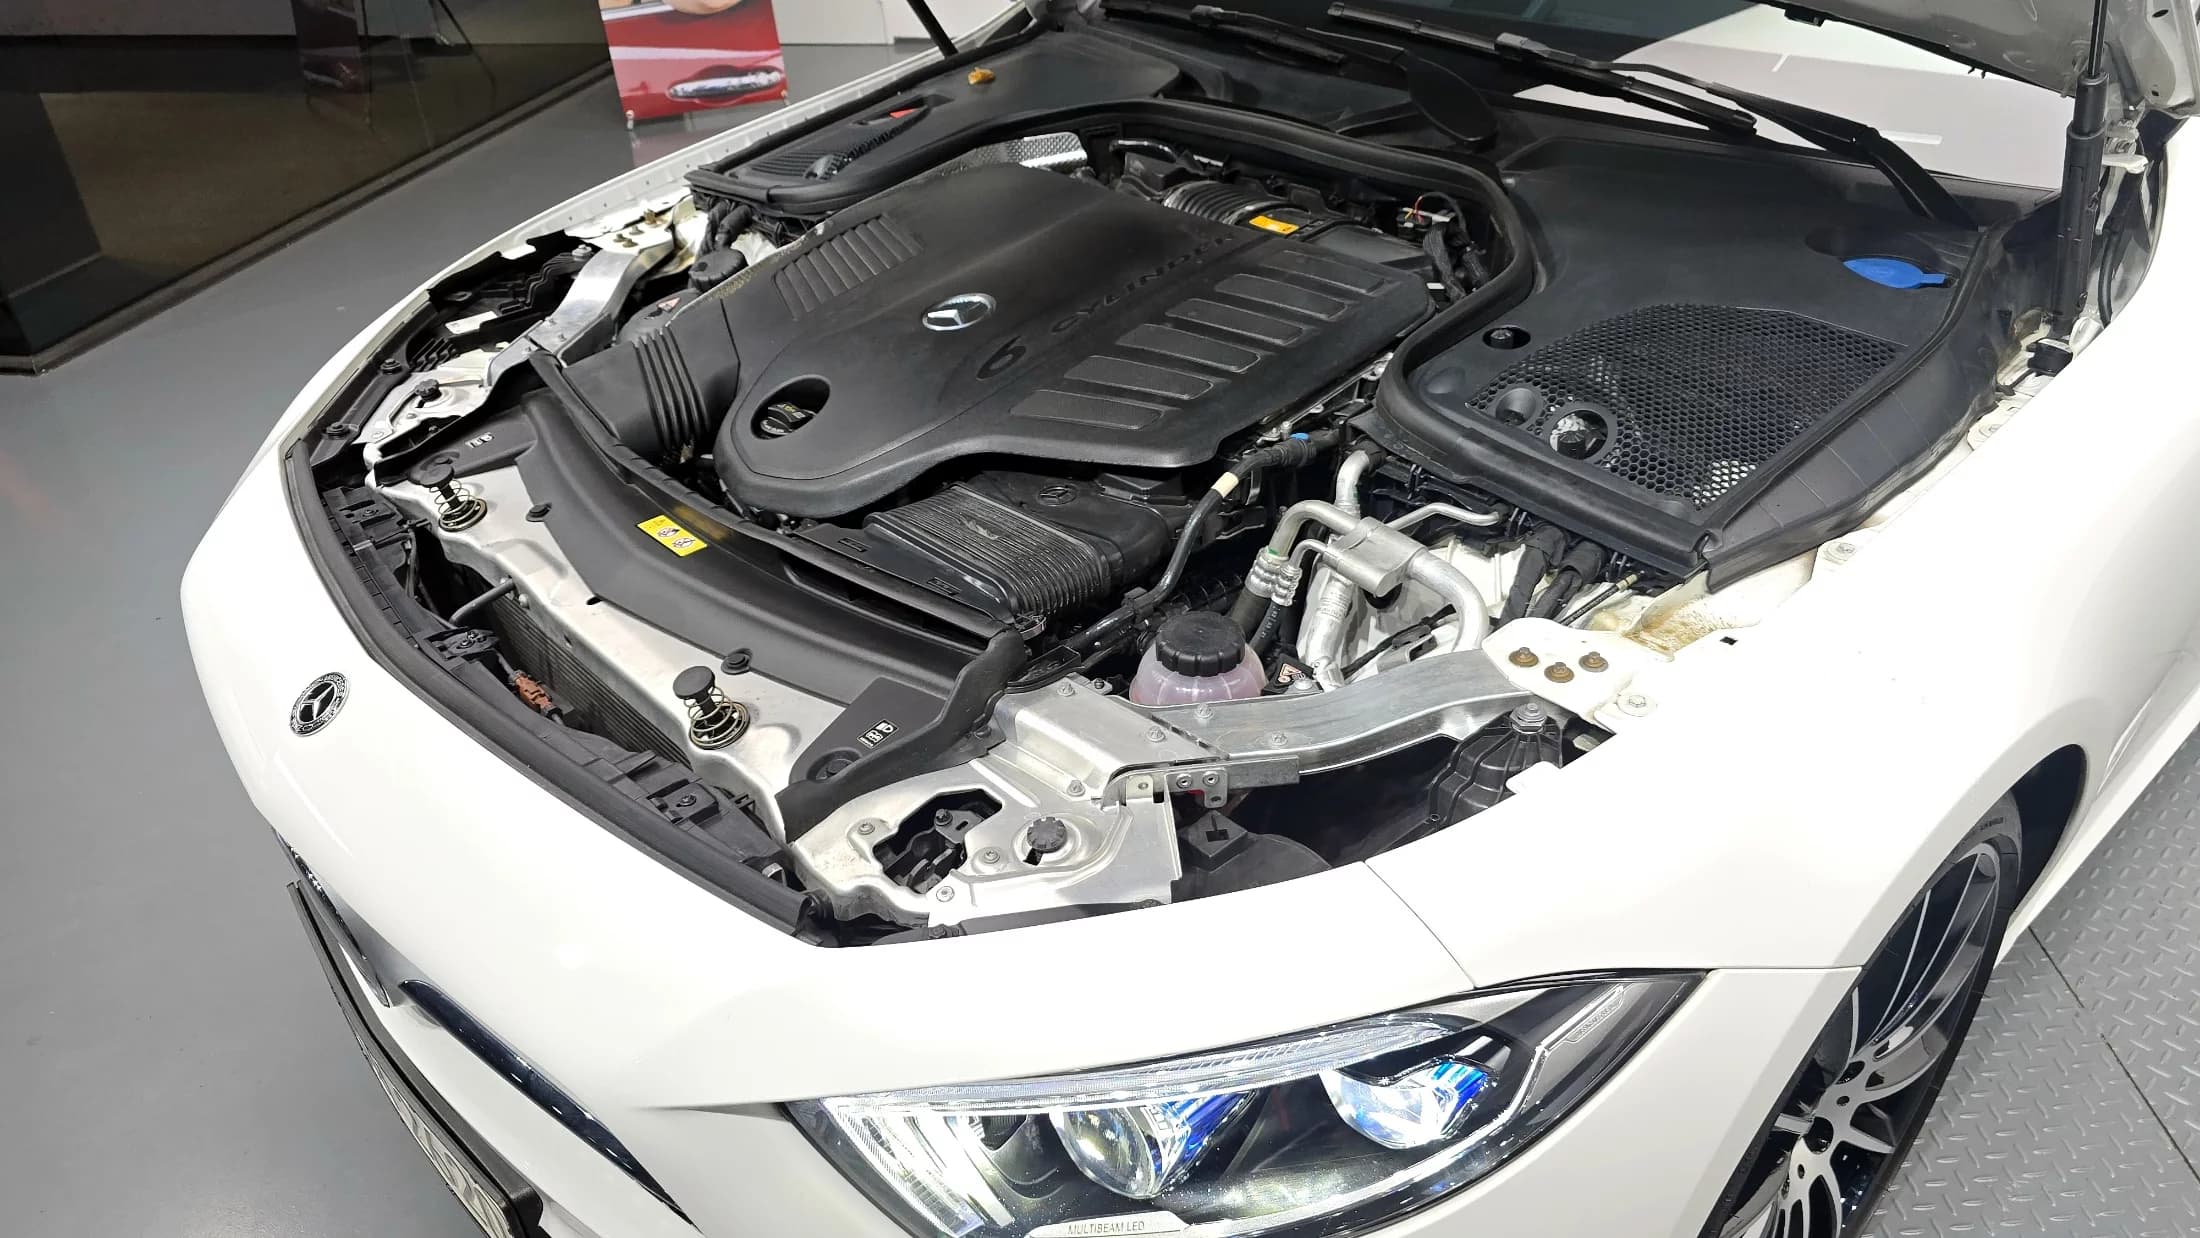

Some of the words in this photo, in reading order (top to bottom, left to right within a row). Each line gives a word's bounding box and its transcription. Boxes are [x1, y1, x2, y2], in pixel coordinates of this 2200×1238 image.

[976, 336, 1027, 380] 6
[1067, 1221, 1124, 1235] MULTIBEAM
[1127, 1221, 1145, 1232] LED
